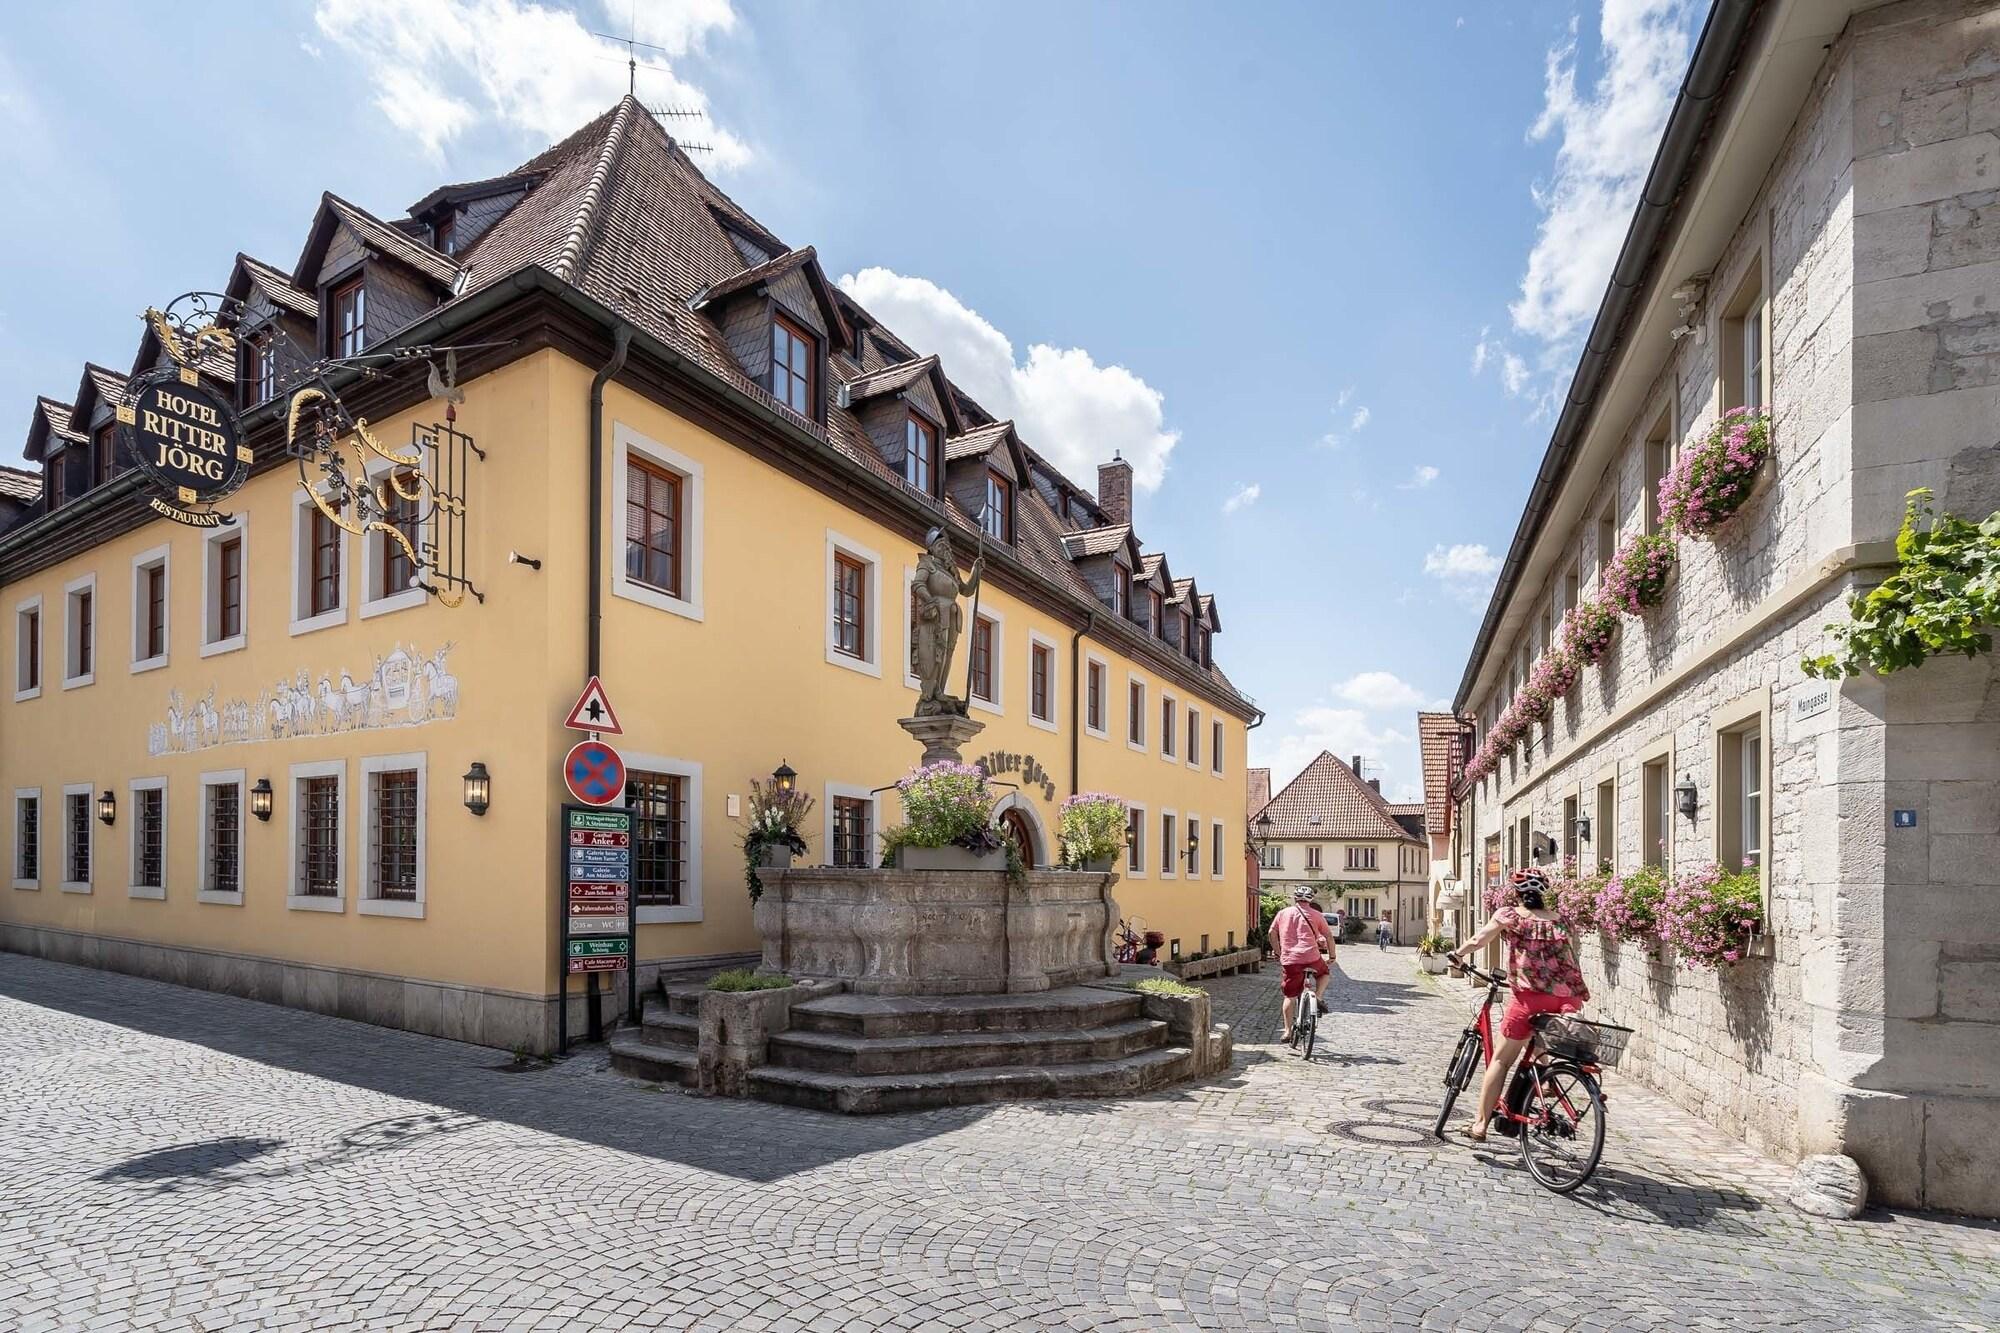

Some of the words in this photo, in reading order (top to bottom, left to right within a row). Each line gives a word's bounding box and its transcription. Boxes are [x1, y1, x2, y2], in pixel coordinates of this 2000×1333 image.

[156, 389, 222, 428] HOTEL
[143, 409, 227, 457] RITTER
[155, 442, 224, 481] JÖRG
[149, 497, 221, 526] RESTAURANT
[1797, 691, 1828, 714] Maingasse
[976, 750, 1022, 780] Ritter
[591, 837, 615, 845] Anker
